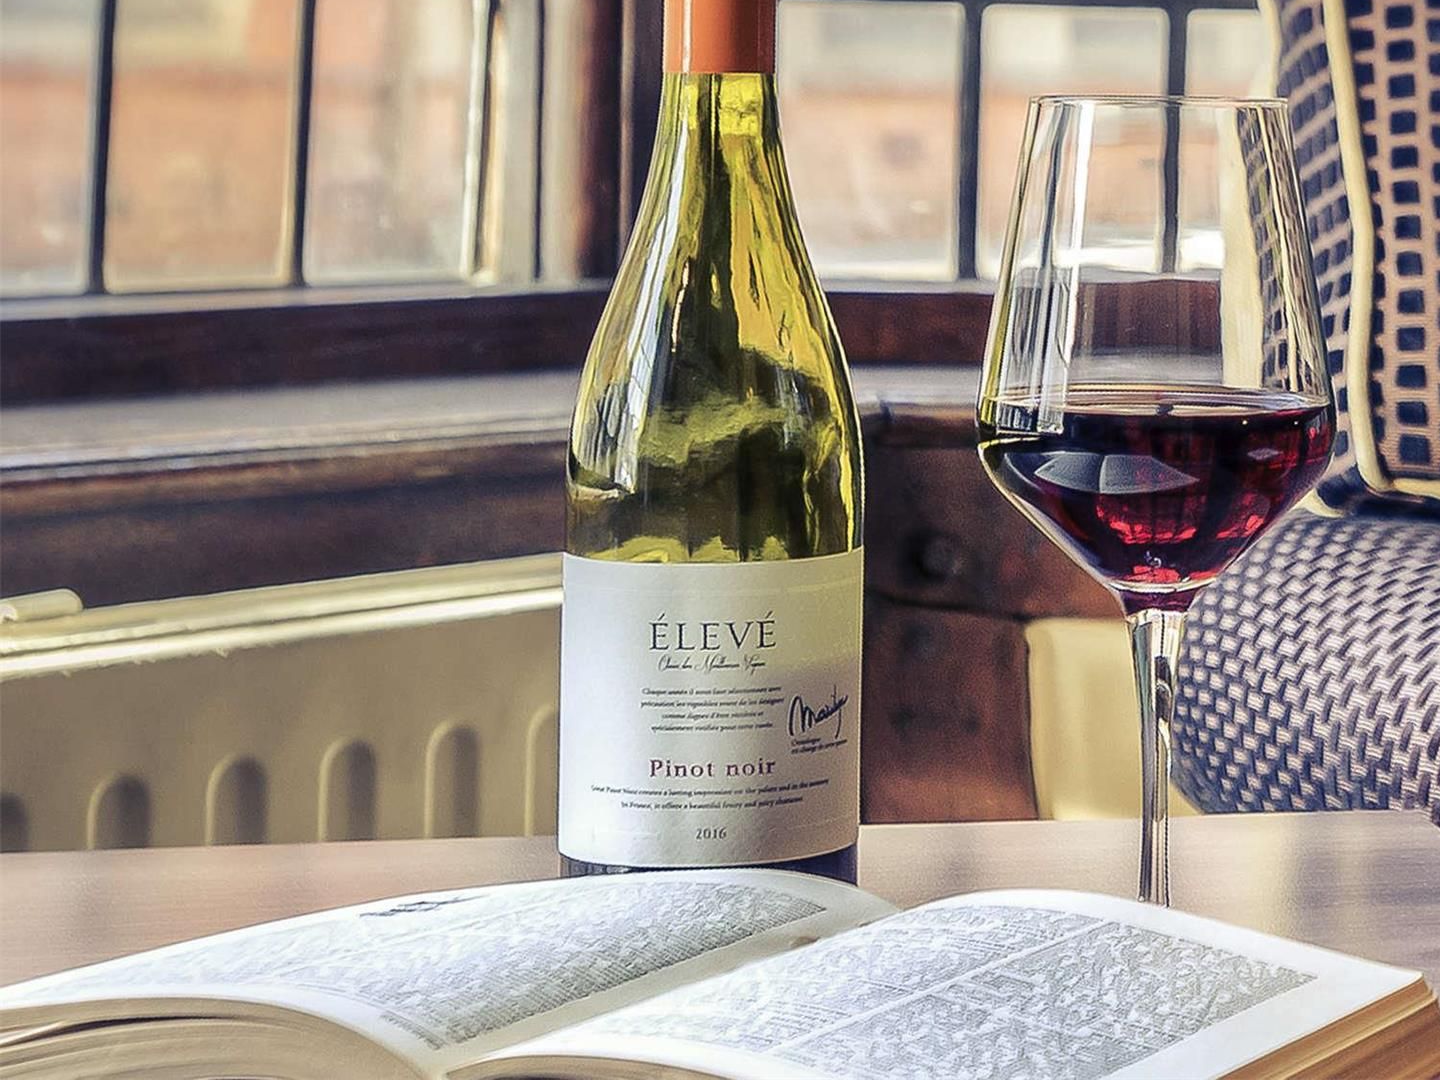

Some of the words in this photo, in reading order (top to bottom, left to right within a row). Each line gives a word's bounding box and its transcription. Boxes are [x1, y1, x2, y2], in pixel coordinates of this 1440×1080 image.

[649, 611, 777, 651] ÉLEVÉ
[649, 759, 716, 778] Pinot
[726, 758, 777, 777] noir
[695, 827, 727, 840] 2016
